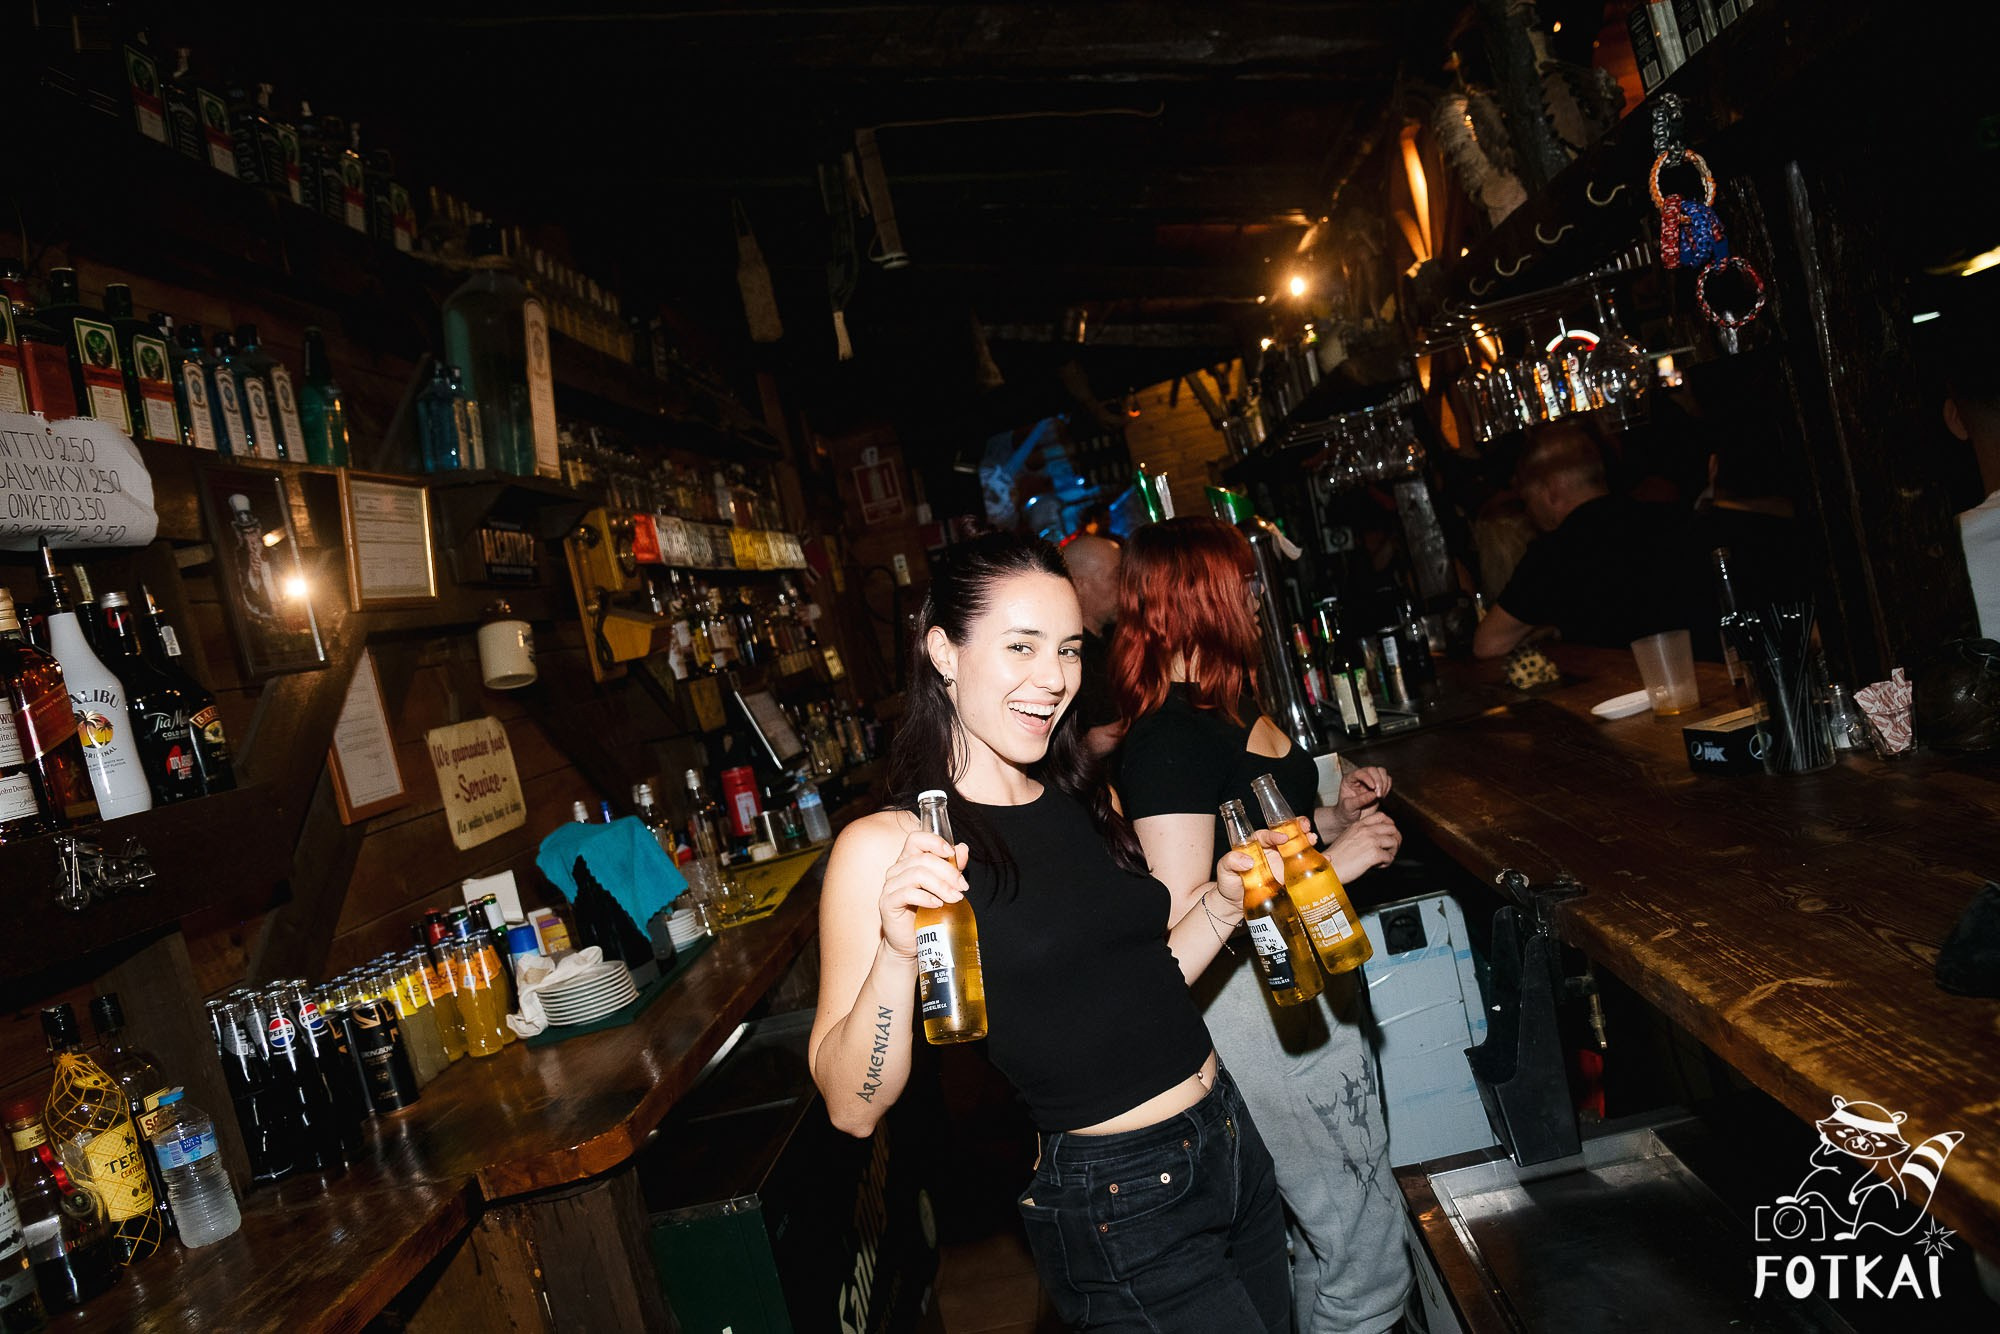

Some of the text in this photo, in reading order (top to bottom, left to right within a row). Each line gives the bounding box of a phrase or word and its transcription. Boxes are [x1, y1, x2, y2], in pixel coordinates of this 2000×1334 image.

[55, 436, 95, 463] 2.50
[69, 689, 121, 709] ALIBU
[917, 931, 938, 945] rona
[1249, 923, 1269, 934] rona
[856, 1005, 894, 1104] ARMENIAN
